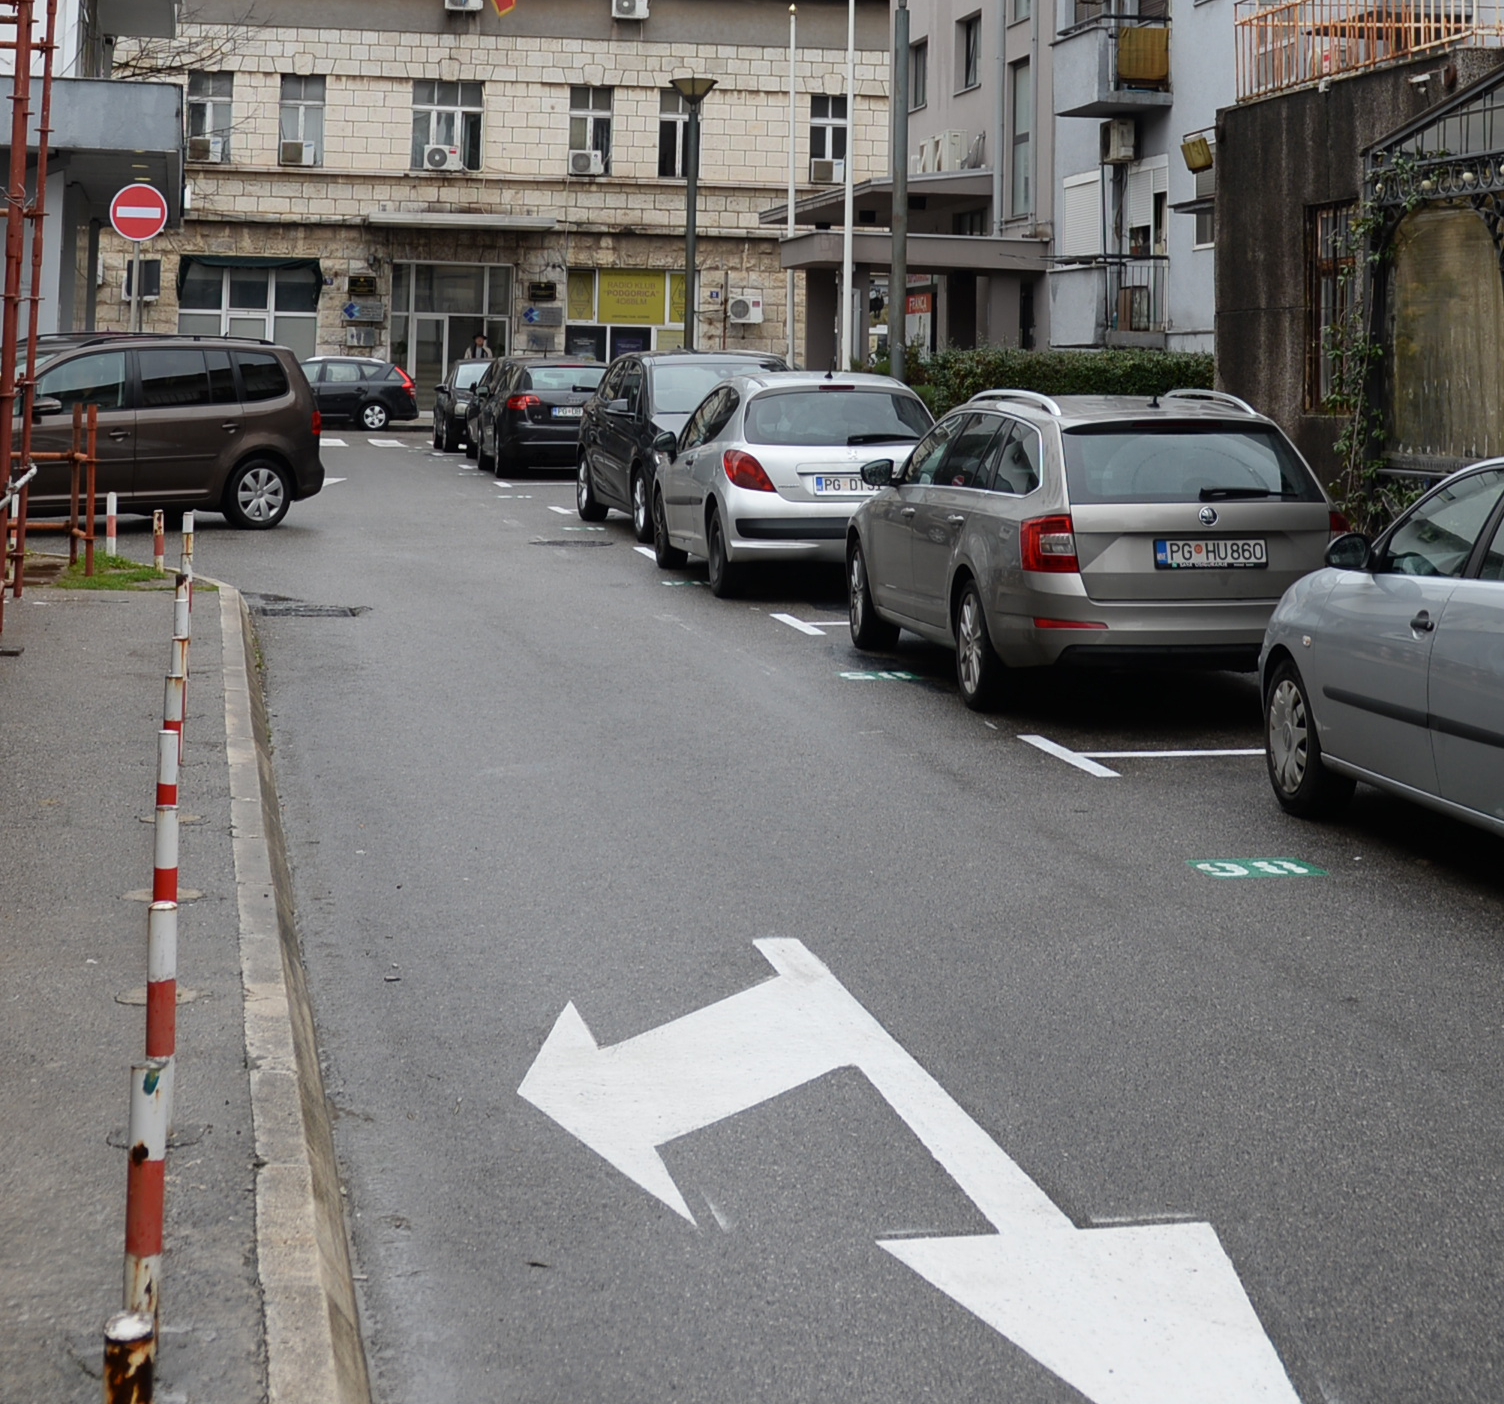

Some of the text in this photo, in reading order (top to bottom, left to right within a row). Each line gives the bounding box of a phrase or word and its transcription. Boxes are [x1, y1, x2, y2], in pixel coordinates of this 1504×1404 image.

[607, 281, 656, 289] RADIO KLUB
[824, 478, 841, 491] PG
[1169, 542, 1193, 561] PG
[1204, 542, 1264, 561] HU860
